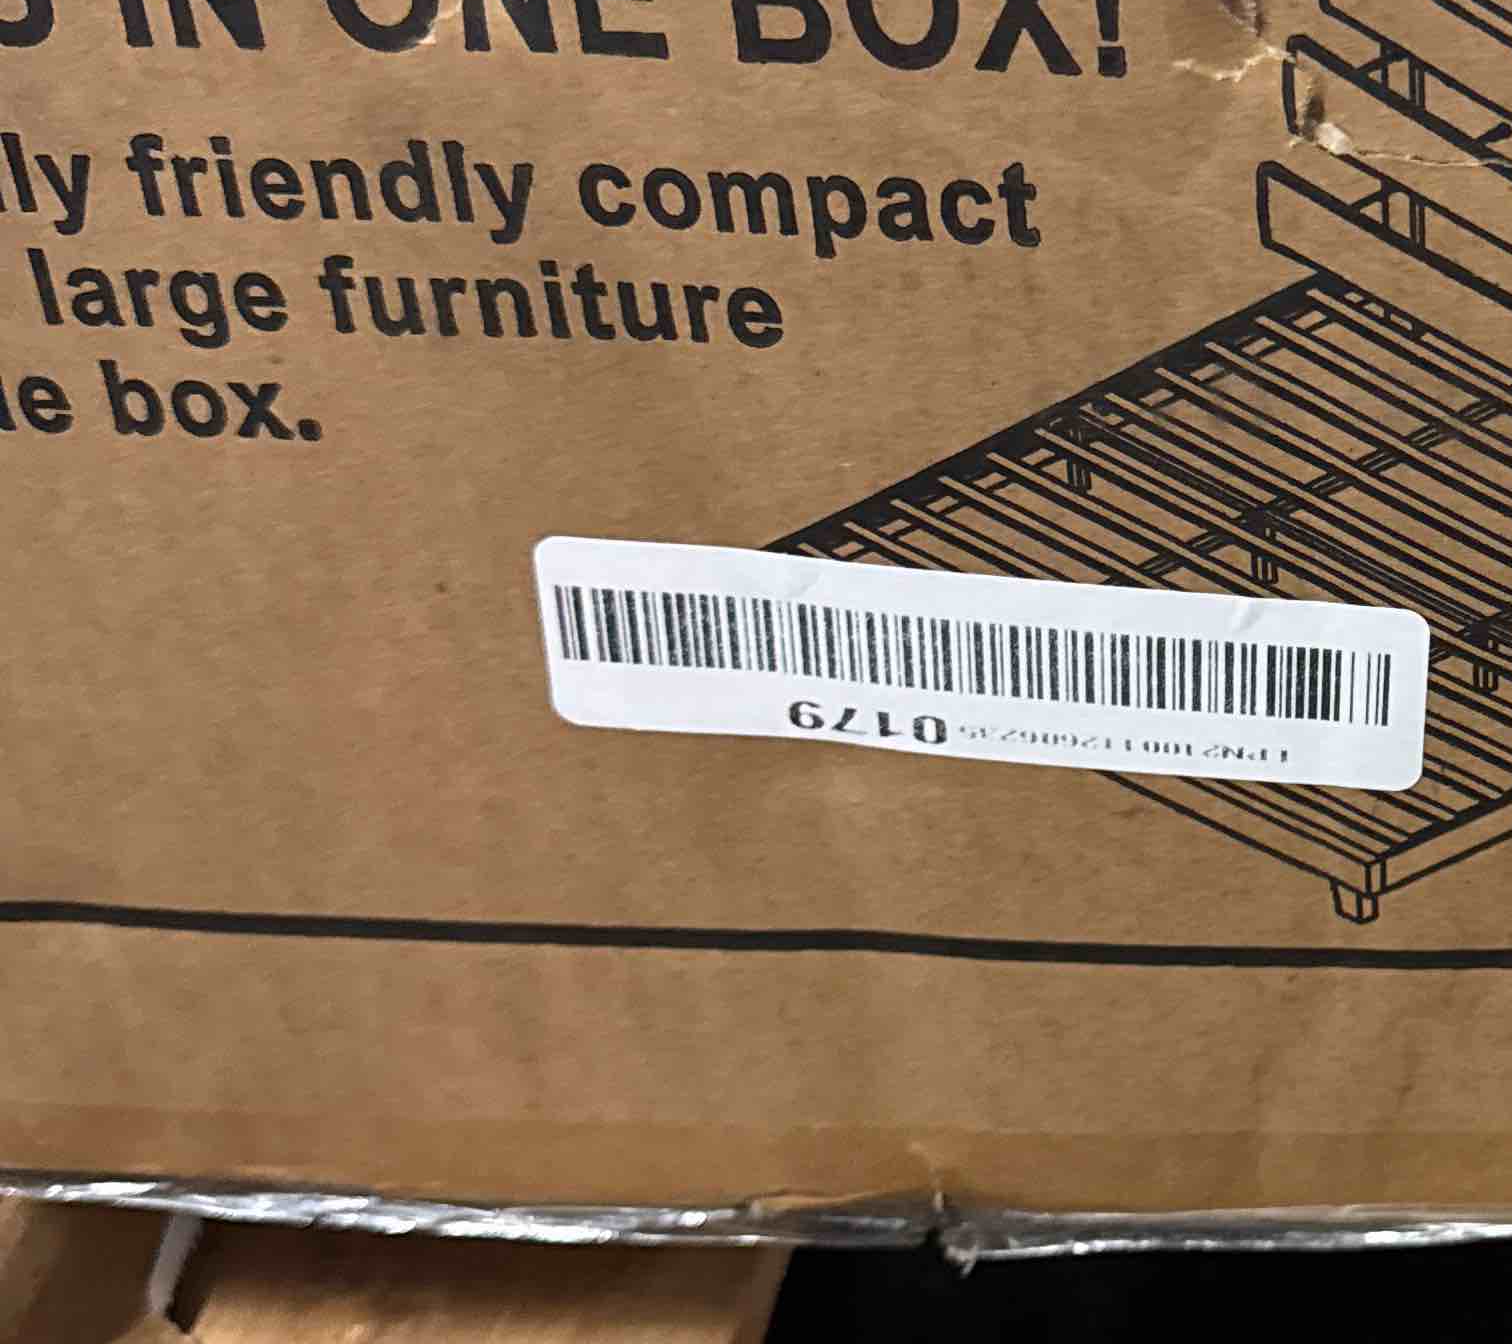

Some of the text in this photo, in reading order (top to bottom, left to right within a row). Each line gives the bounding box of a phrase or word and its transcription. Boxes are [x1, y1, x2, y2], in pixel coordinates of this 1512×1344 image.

[125, 132, 534, 244] friendly
[576, 161, 1041, 258] compact
[27, 247, 783, 348] large furniture
[99, 359, 322, 442] box.
[787, 699, 948, 746] 0179
